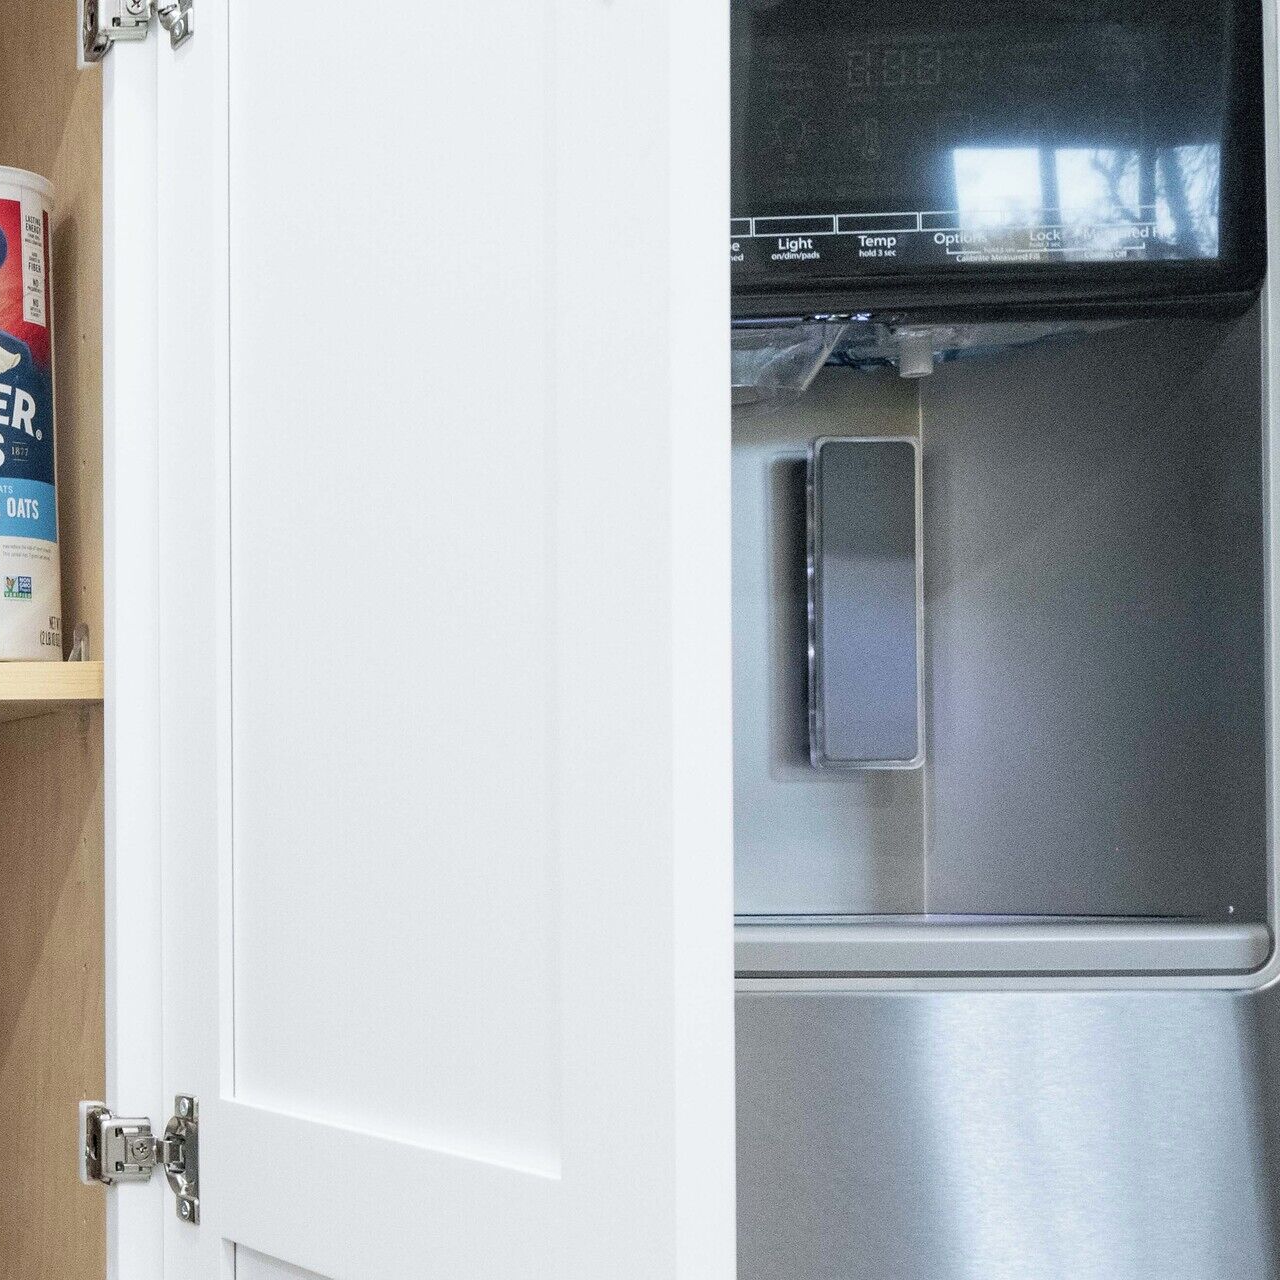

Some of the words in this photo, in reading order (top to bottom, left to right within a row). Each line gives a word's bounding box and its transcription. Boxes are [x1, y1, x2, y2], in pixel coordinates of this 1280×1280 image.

[858, 235, 896, 249] Temp
[934, 232, 988, 246] Options
[1030, 230, 1060, 242] Lock
[778, 237, 813, 252] Light
[771, 251, 820, 261] on/dim/pads
[859, 250, 876, 258] hold
[884, 249, 896, 257] sec
[956, 254, 989, 263] Calibrate
[11, 446, 29, 457] 1877
[7, 498, 39, 519] OATS
